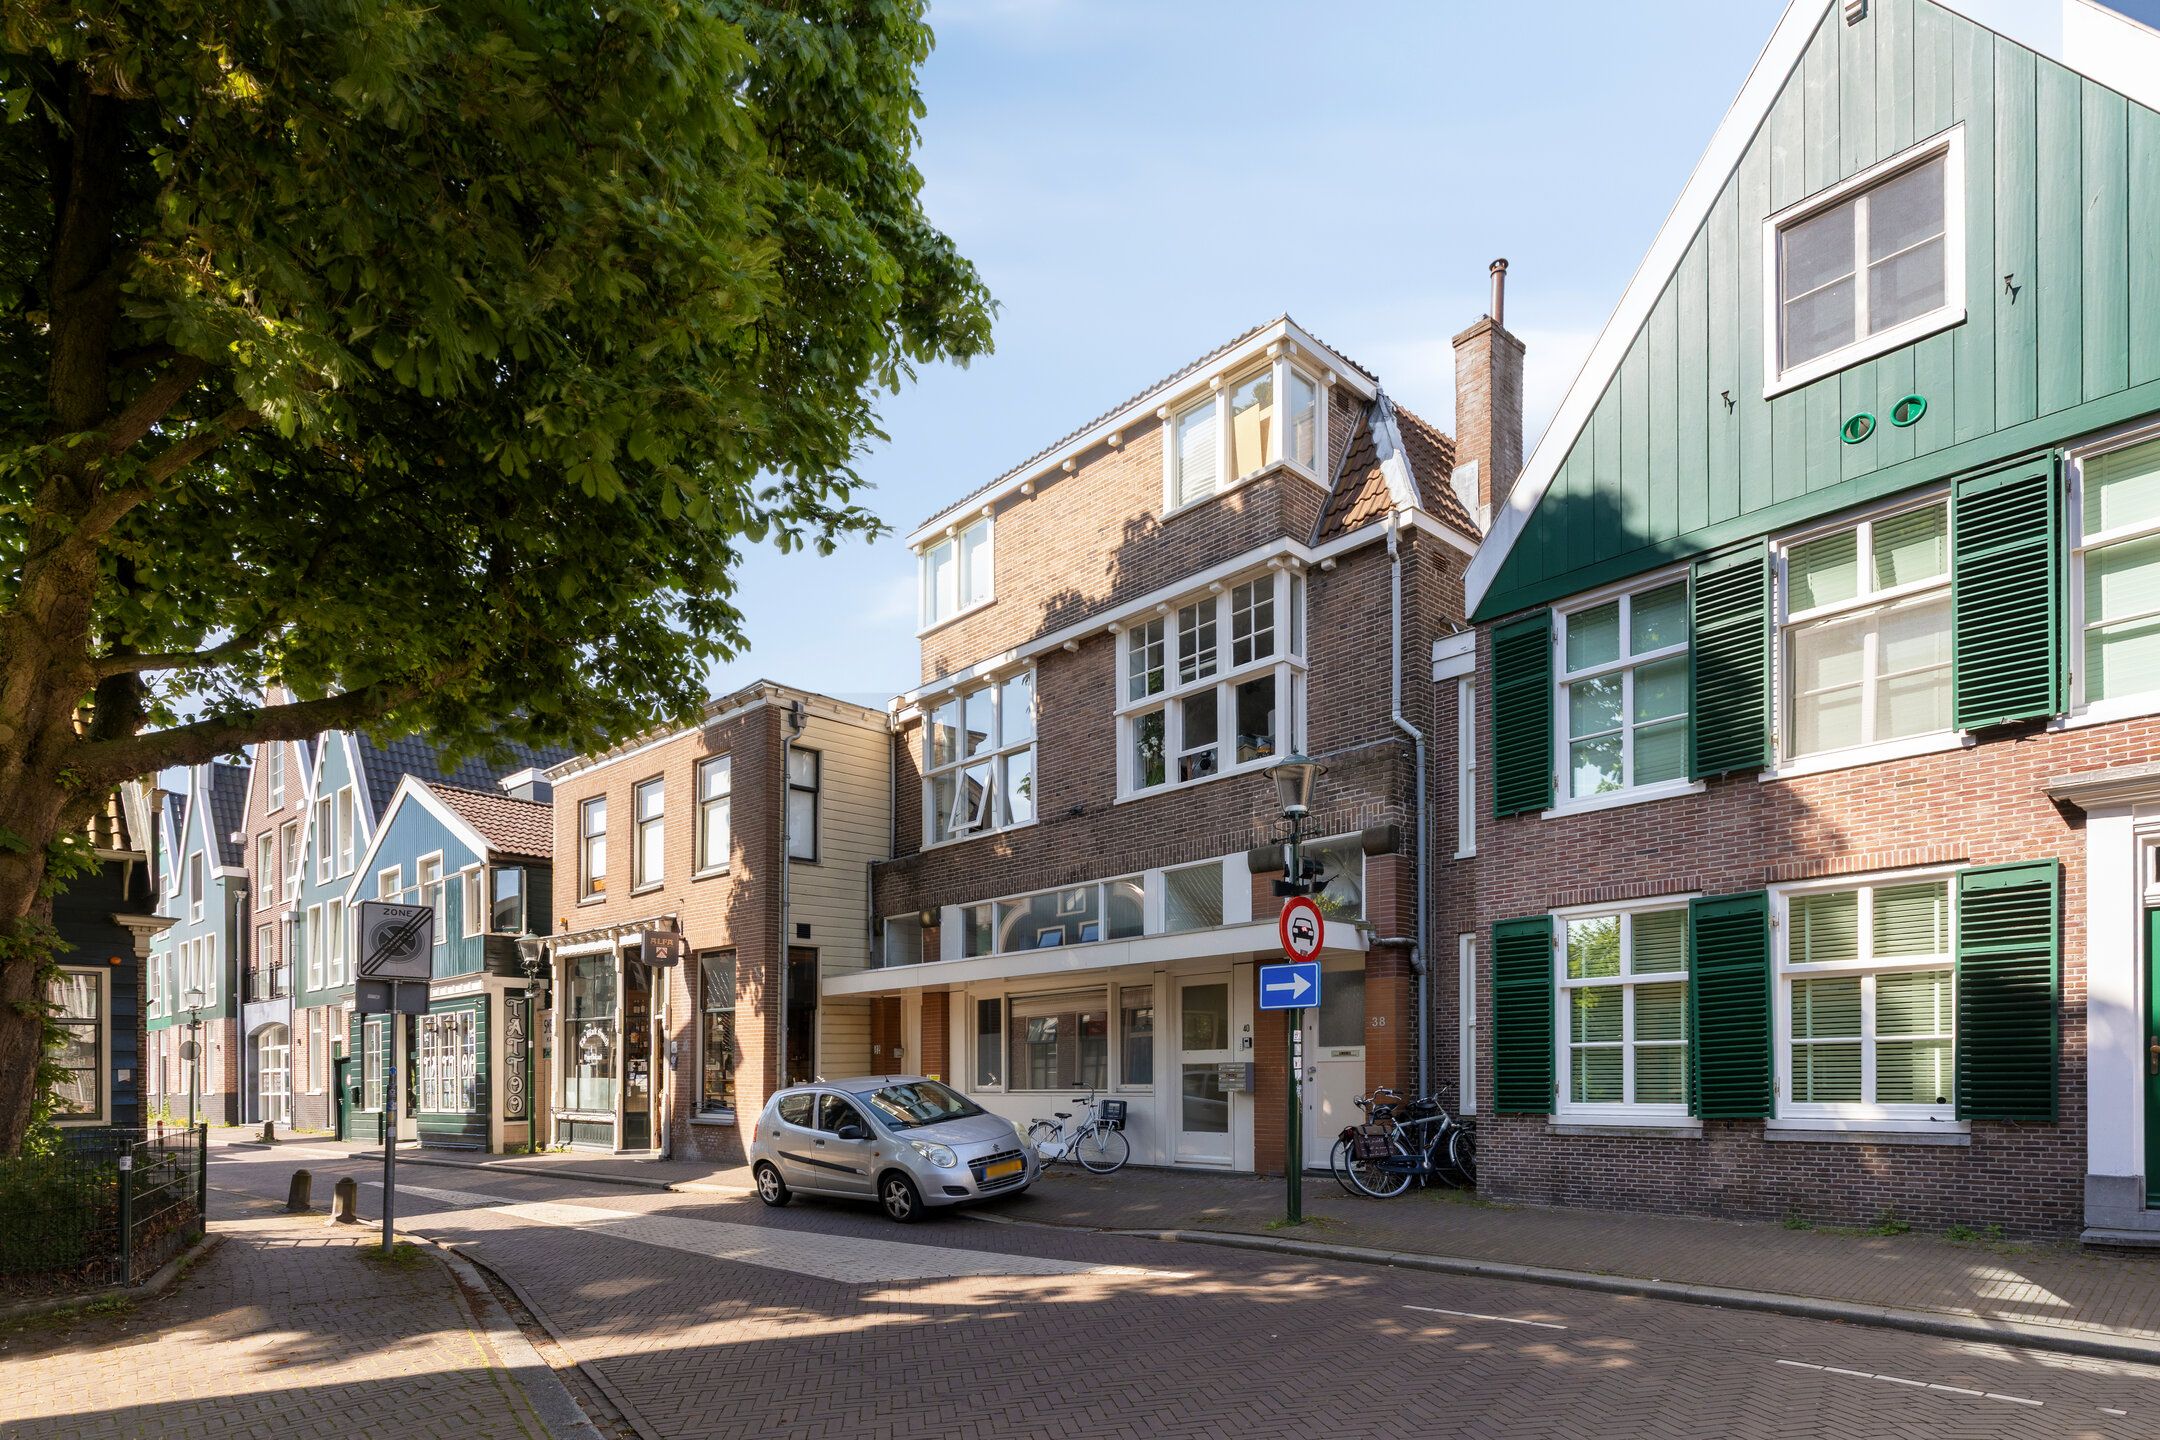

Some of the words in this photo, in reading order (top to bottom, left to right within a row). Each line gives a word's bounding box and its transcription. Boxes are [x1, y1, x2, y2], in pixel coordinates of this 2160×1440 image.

[383, 907, 413, 917] ZONE
[650, 937, 674, 946] ALFA
[1371, 1016, 1386, 1027] 38
[1243, 1023, 1251, 1033] 40
[505, 997, 525, 1114] TATTOO
